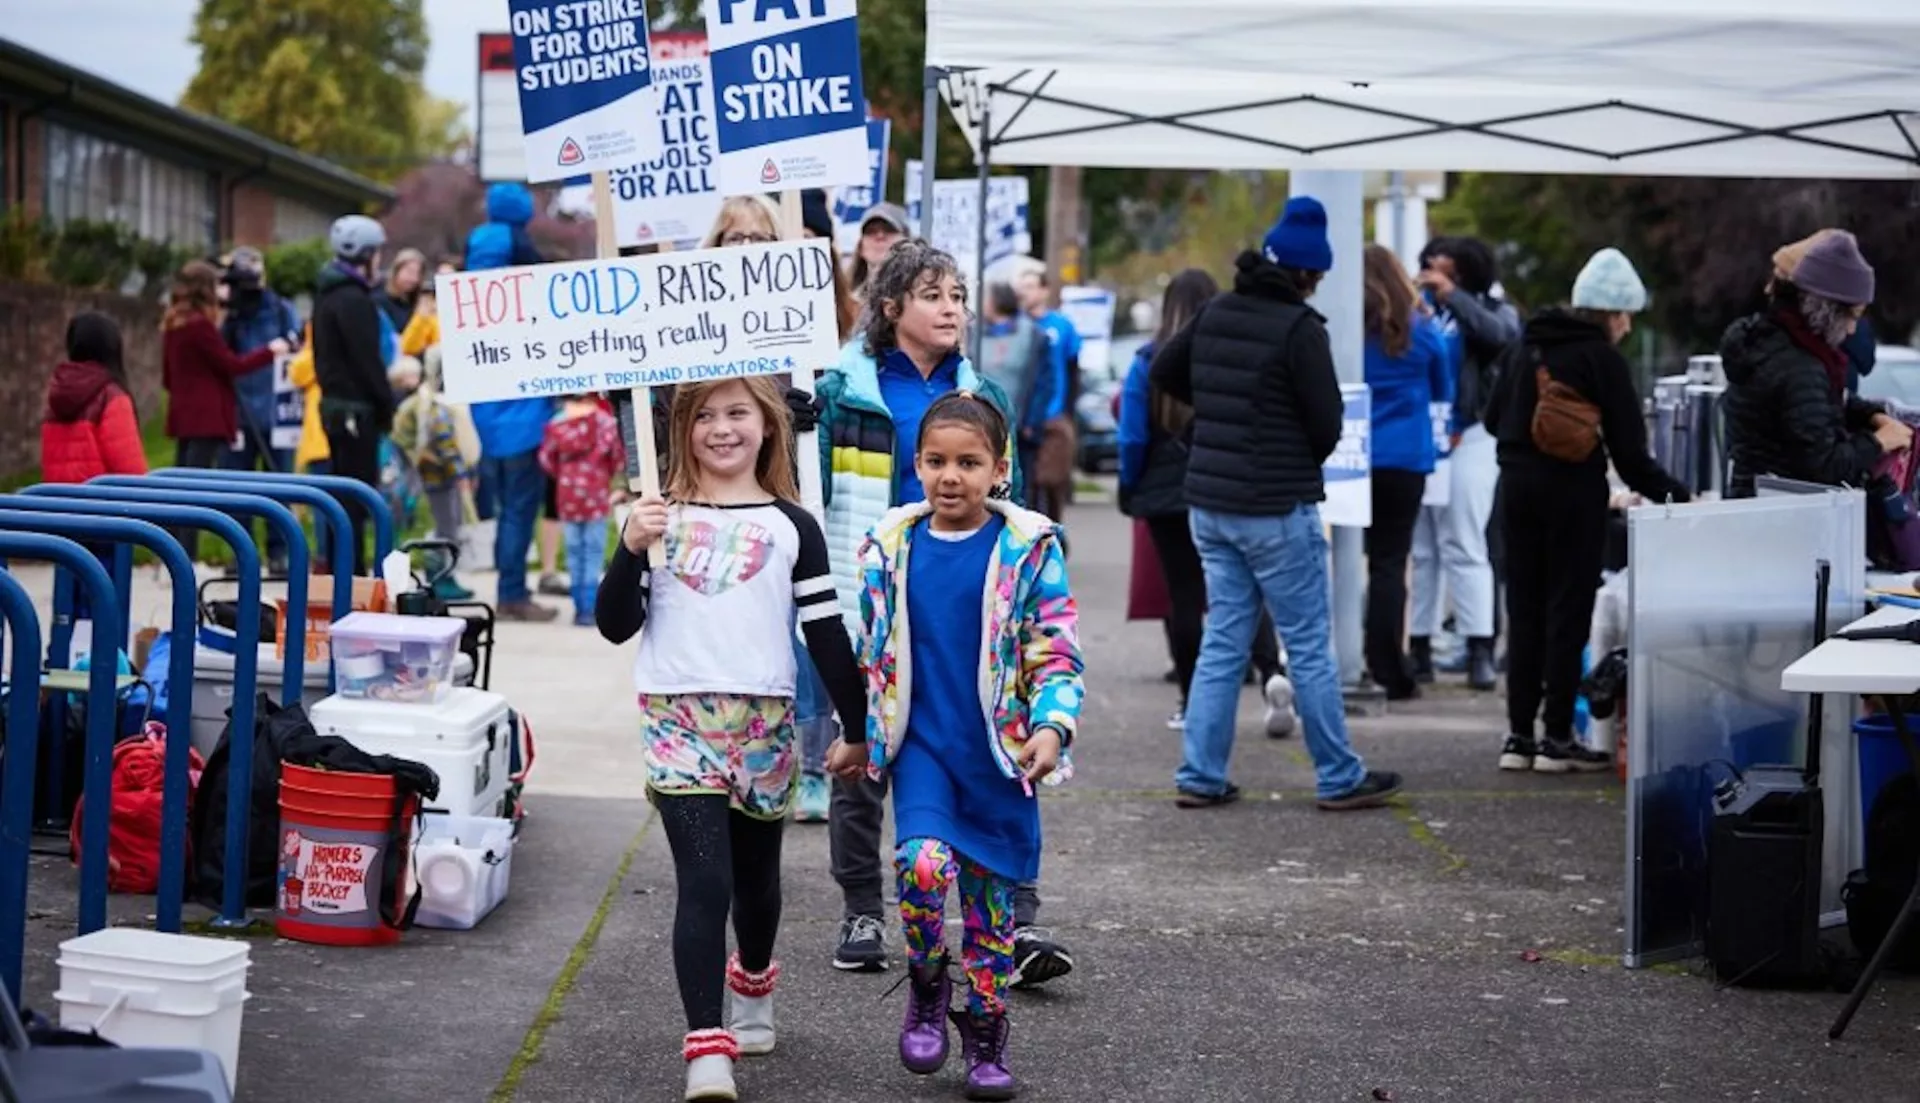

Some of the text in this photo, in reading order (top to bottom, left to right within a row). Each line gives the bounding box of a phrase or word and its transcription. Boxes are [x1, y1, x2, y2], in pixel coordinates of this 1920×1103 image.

[512, 0, 643, 36] ON STRIKE
[530, 30, 585, 62] FOR
[587, 20, 638, 53] OUR
[751, 42, 803, 82] ON
[521, 46, 648, 91] STUDENTS
[723, 75, 853, 122] STRIKE
[609, 168, 716, 201] OR ALL
[450, 247, 835, 329] HOT, COLD, RATS, MOLD
[467, 300, 815, 370] this is getting really OLD!
[604, 367, 683, 387] PORTLAND
[687, 356, 780, 380] EDUCATORS
